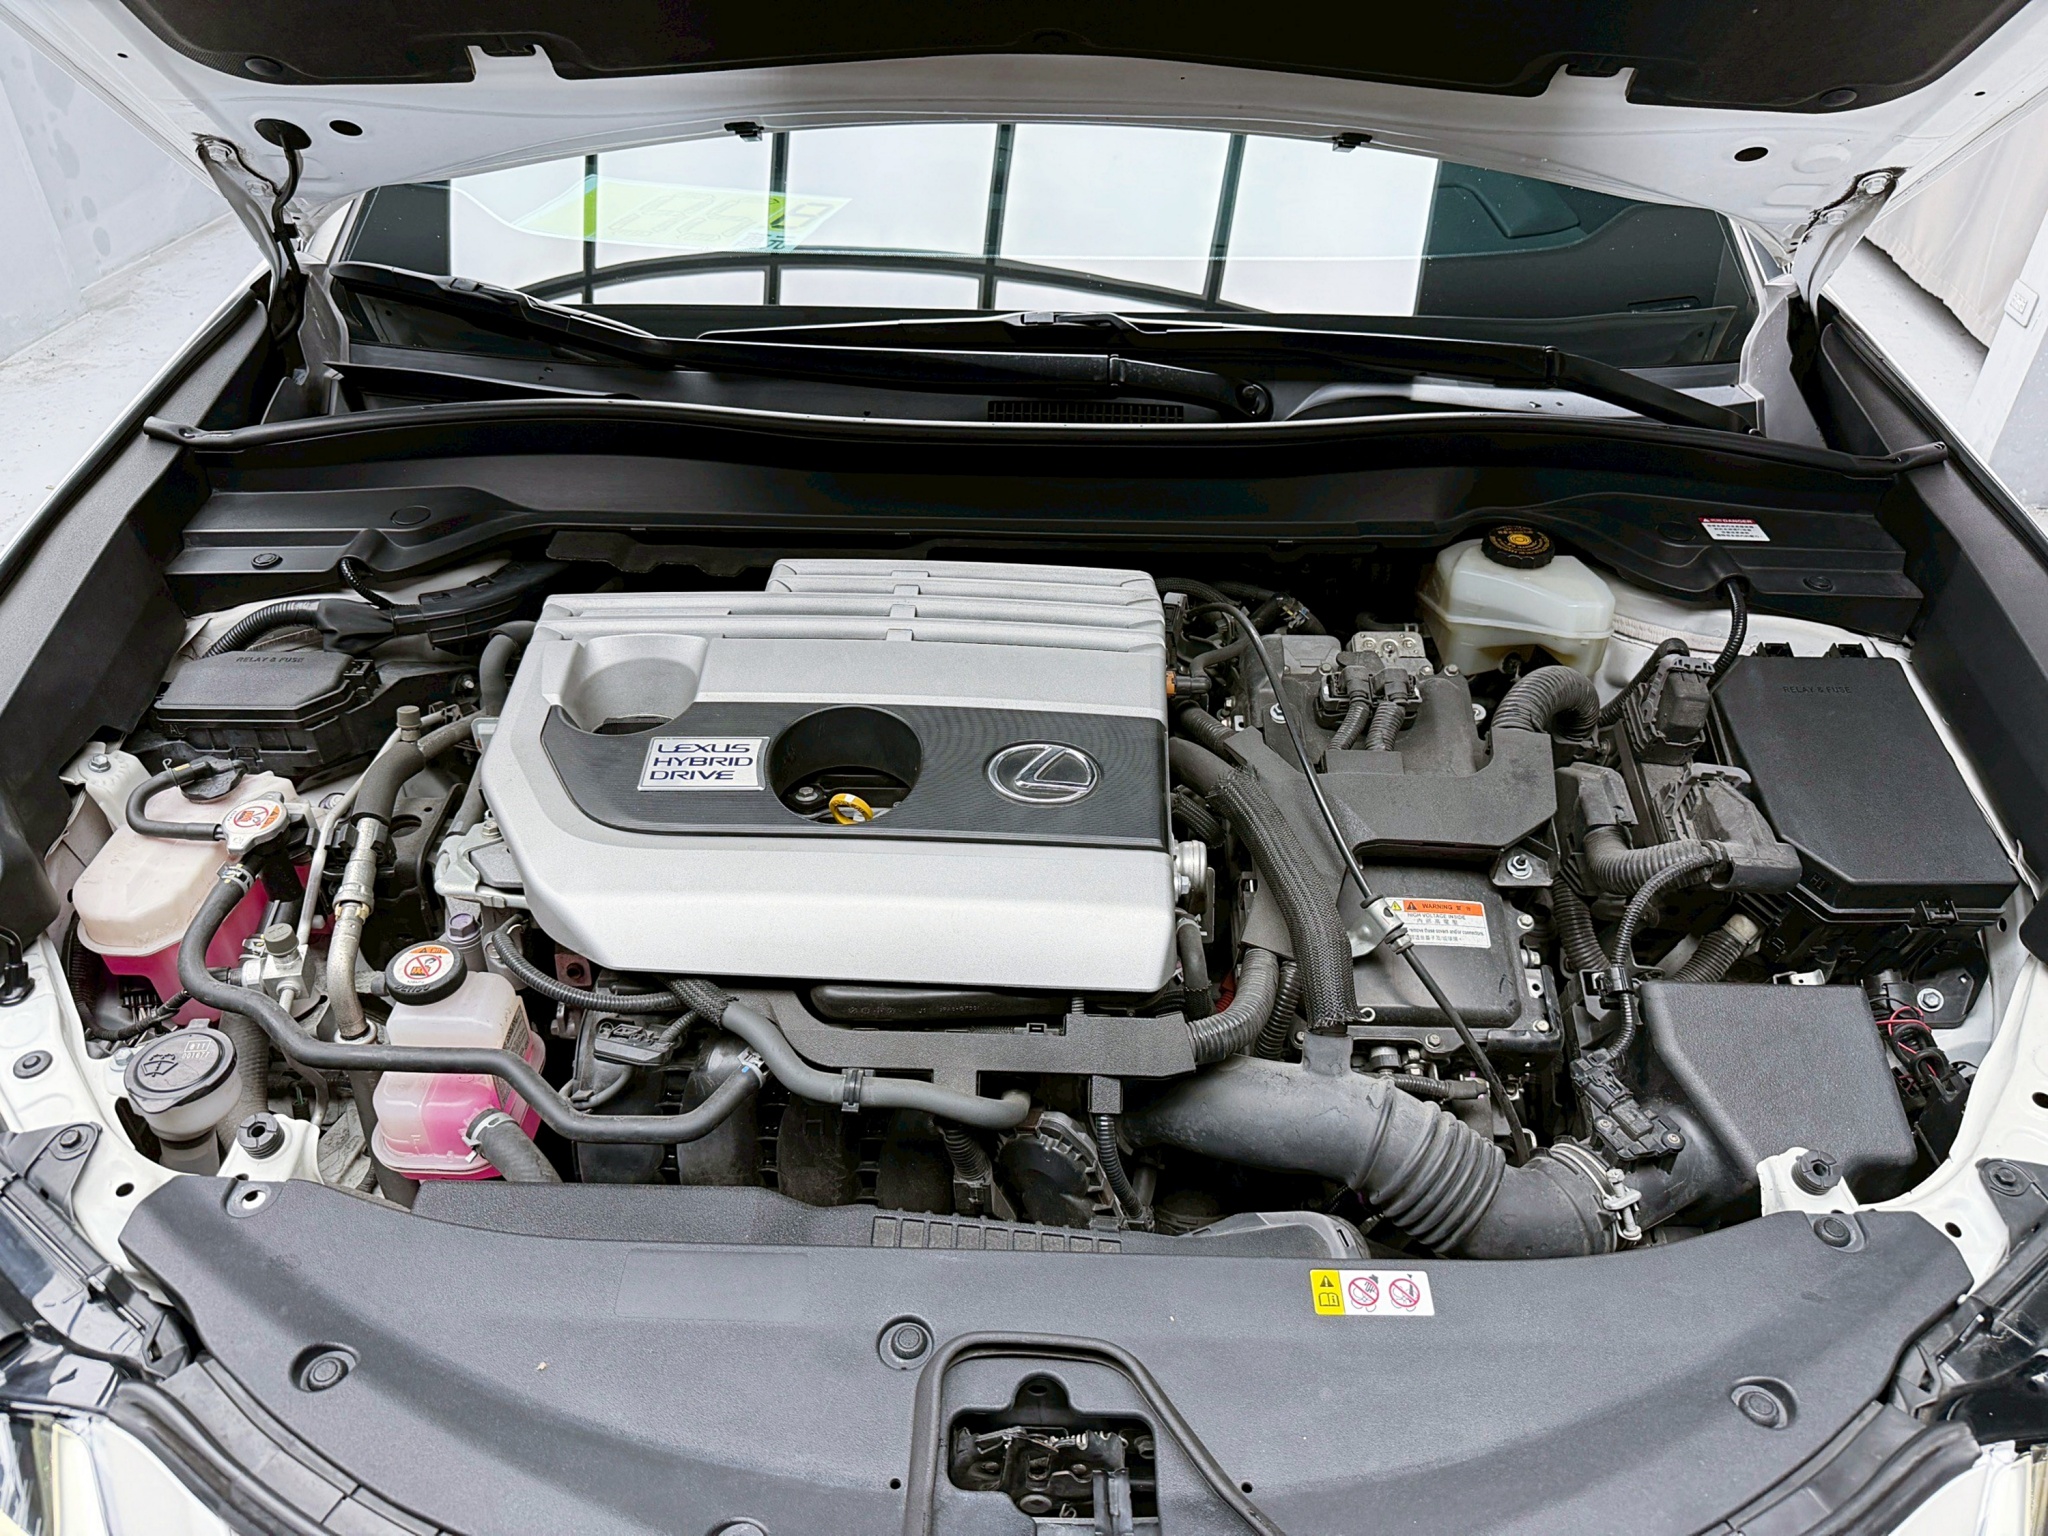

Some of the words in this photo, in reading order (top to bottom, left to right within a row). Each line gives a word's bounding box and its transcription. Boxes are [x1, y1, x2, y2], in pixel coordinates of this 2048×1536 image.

[1825, 686, 1852, 694] FUSE
[657, 743, 751, 753] LEXUS
[653, 757, 753, 766] HYBRID
[649, 770, 735, 780] DRIVE
